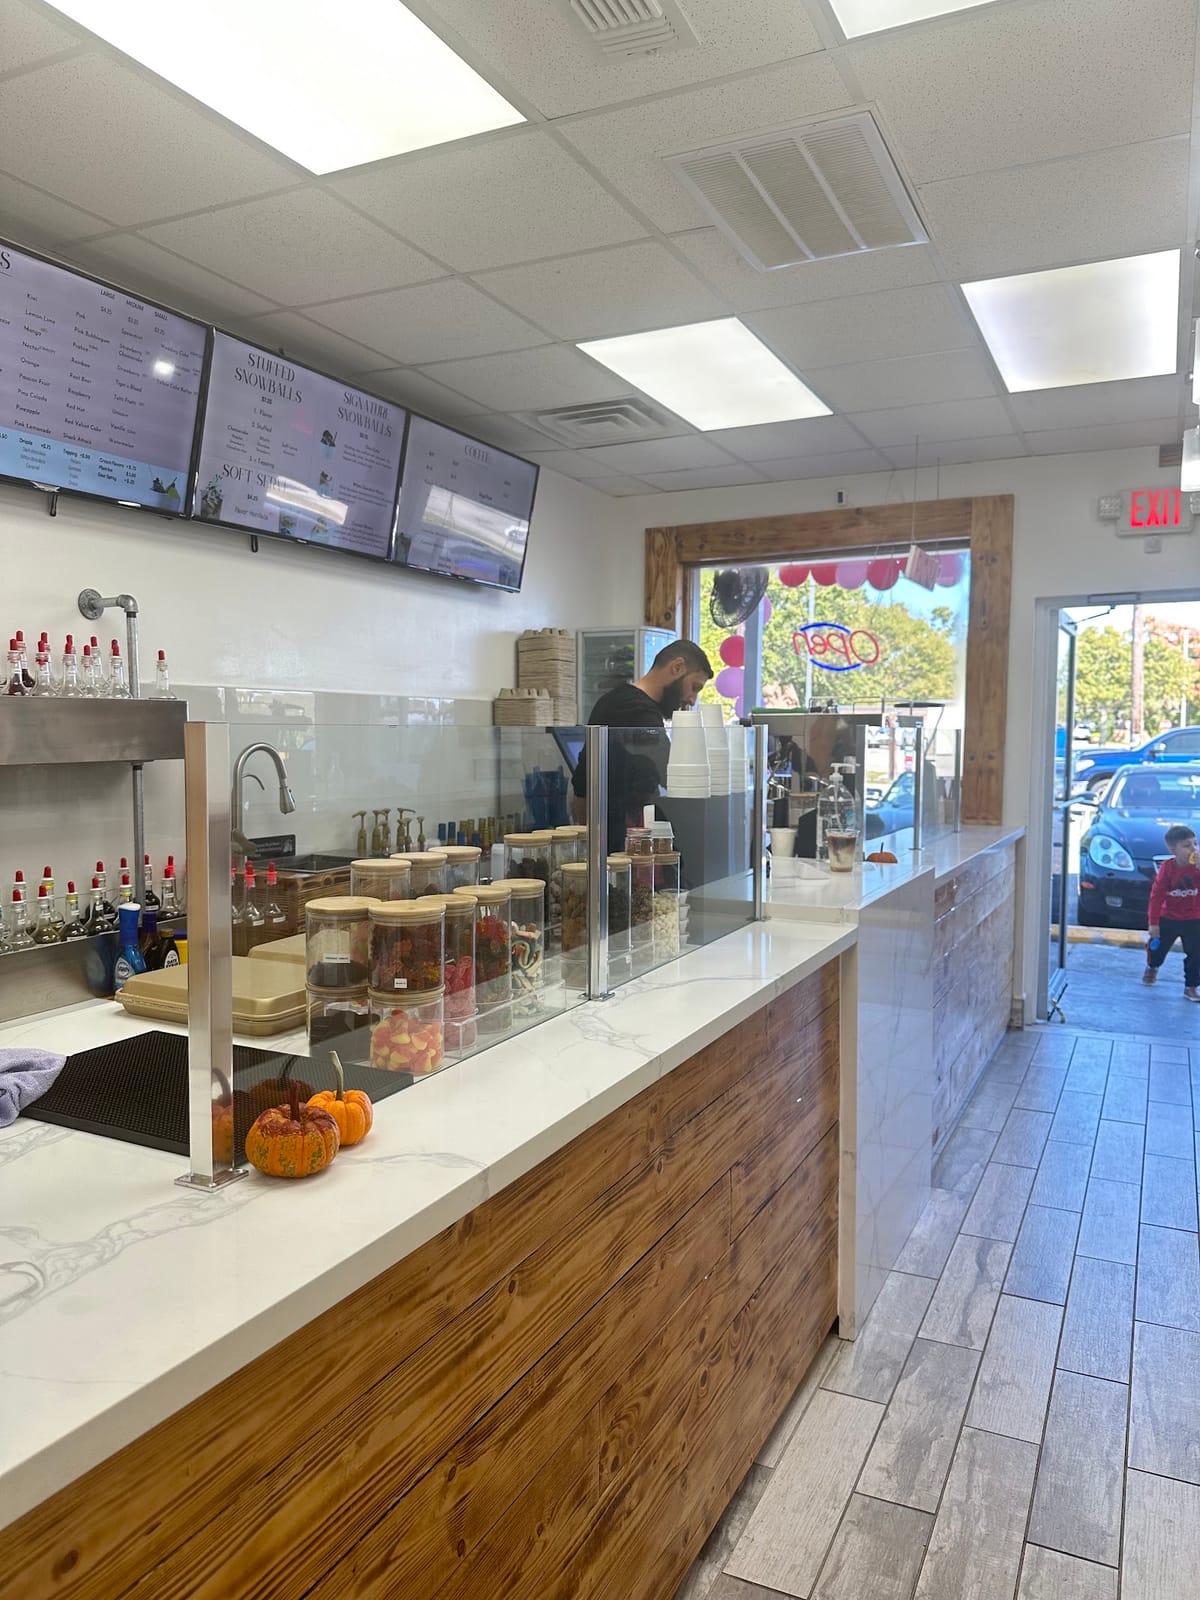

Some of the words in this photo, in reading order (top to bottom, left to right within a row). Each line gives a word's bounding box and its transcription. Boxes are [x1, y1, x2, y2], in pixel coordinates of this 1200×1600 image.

[126, 300, 144, 311] MEDIUM
[247, 352, 295, 383] STUFFED
[234, 367, 303, 404] SNOWBALLS
[343, 390, 392, 420] SIGNATURE
[337, 407, 393, 438] SNOWBALLS
[464, 445, 489, 463] COFFEE
[223, 463, 253, 484] SOFT
[1130, 487, 1181, 527] EXIT
